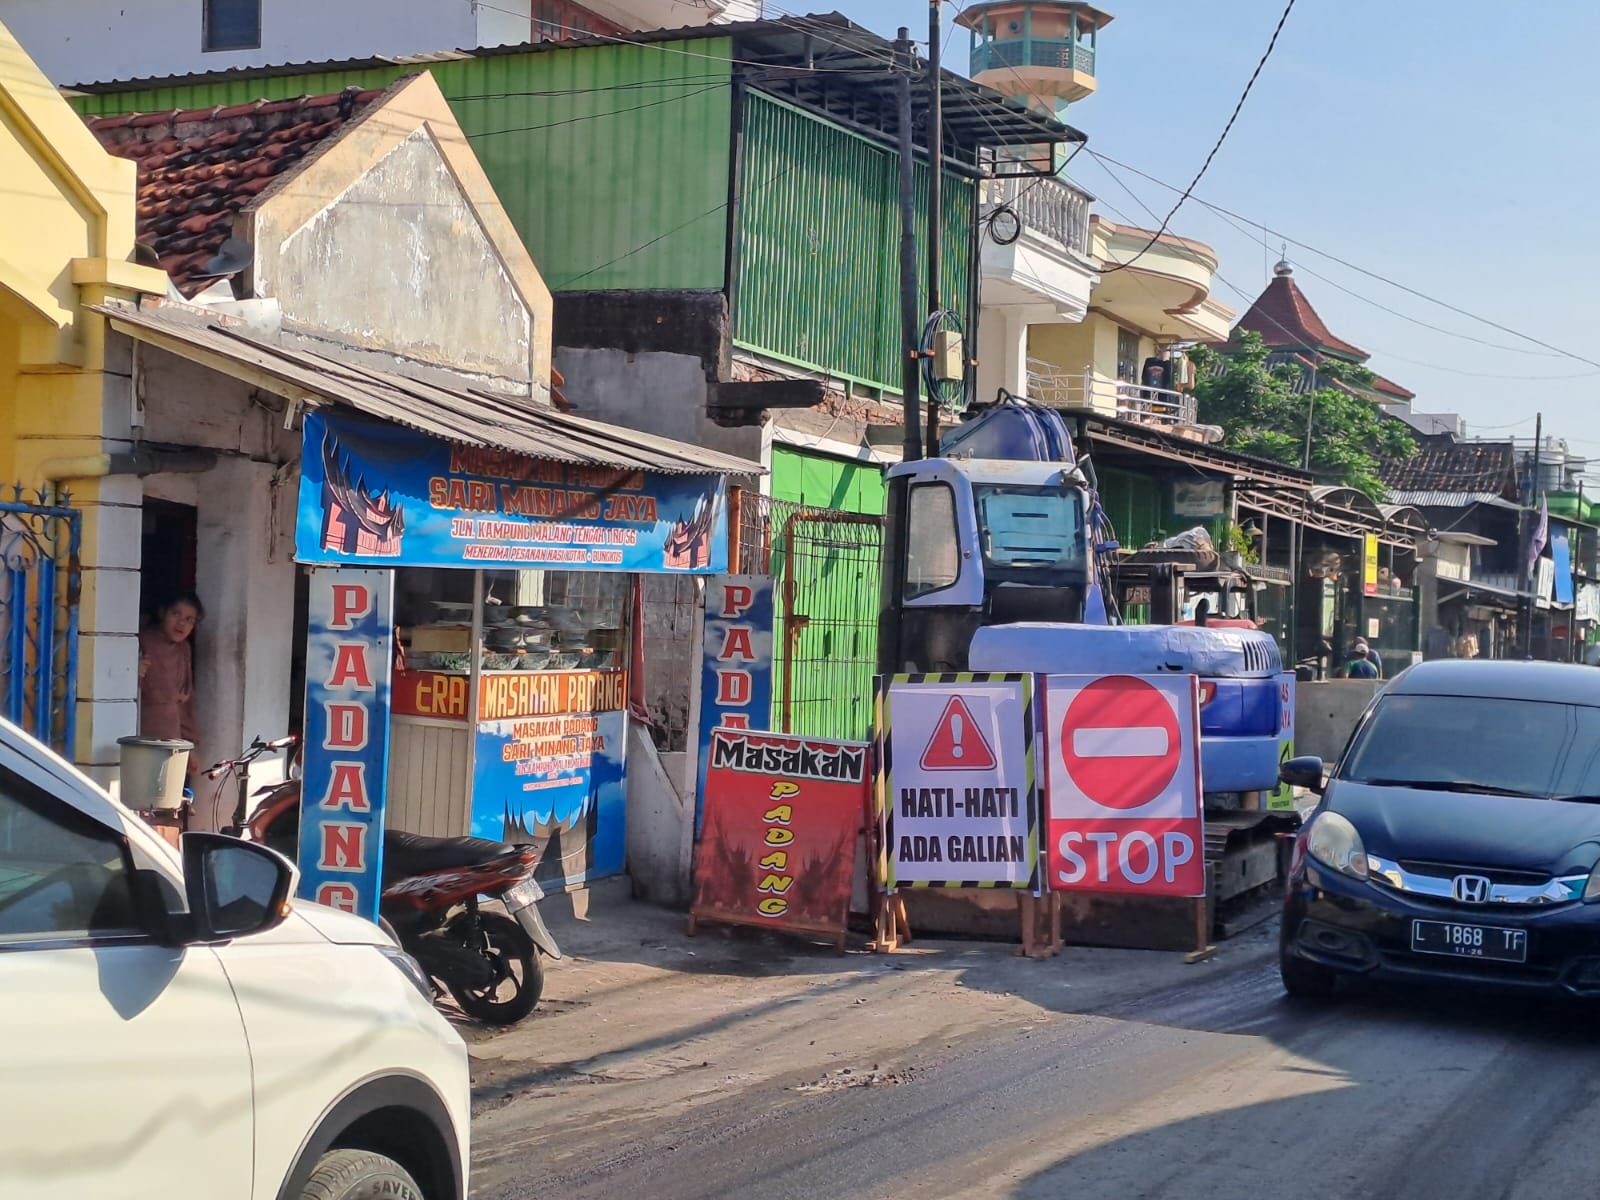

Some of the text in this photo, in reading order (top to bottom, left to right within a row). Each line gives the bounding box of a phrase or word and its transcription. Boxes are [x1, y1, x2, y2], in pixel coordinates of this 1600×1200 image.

[430, 477, 657, 522] SARI MINANG JAYA
[478, 522, 530, 541] KAMPUNG
[532, 525, 572, 543] MALANG
[574, 527, 605, 544] TENGAH
[464, 545, 510, 559] MENERIMA
[511, 547, 547, 561] PESANAN
[484, 673, 623, 718] MASAKAN PADANG
[512, 717, 598, 740] MASAKAN PADANG
[502, 735, 605, 761] SARI MINANG JAYA
[901, 788, 1019, 818] HATI-HATI
[757, 781, 800, 917] PADANG
[899, 836, 1025, 862] ADA GALIAN
[1058, 830, 1194, 884] STOP
[1416, 922, 1425, 941] L
[1444, 924, 1483, 947] 1868
